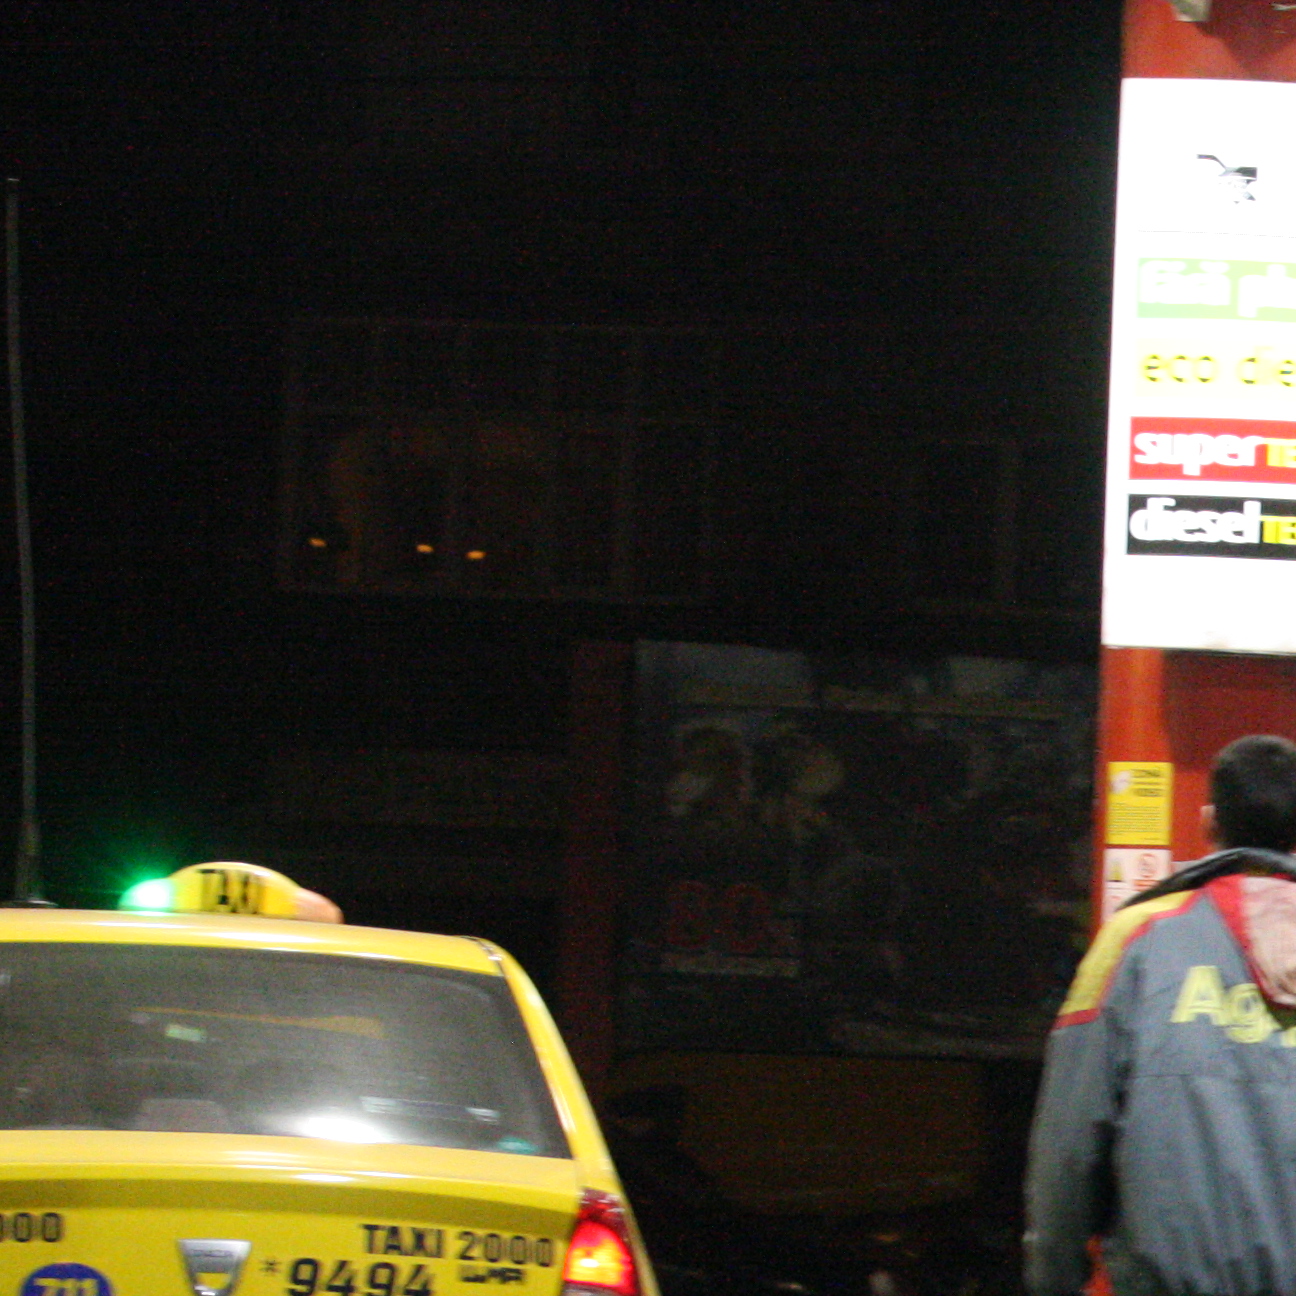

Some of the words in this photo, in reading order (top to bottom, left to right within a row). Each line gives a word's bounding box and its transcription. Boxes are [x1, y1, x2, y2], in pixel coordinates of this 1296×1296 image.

[1141, 354, 1218, 383] eco
[0, 1211, 64, 1243] 00
[359, 1222, 445, 1258] TAXI
[457, 1230, 557, 1268] 2000
